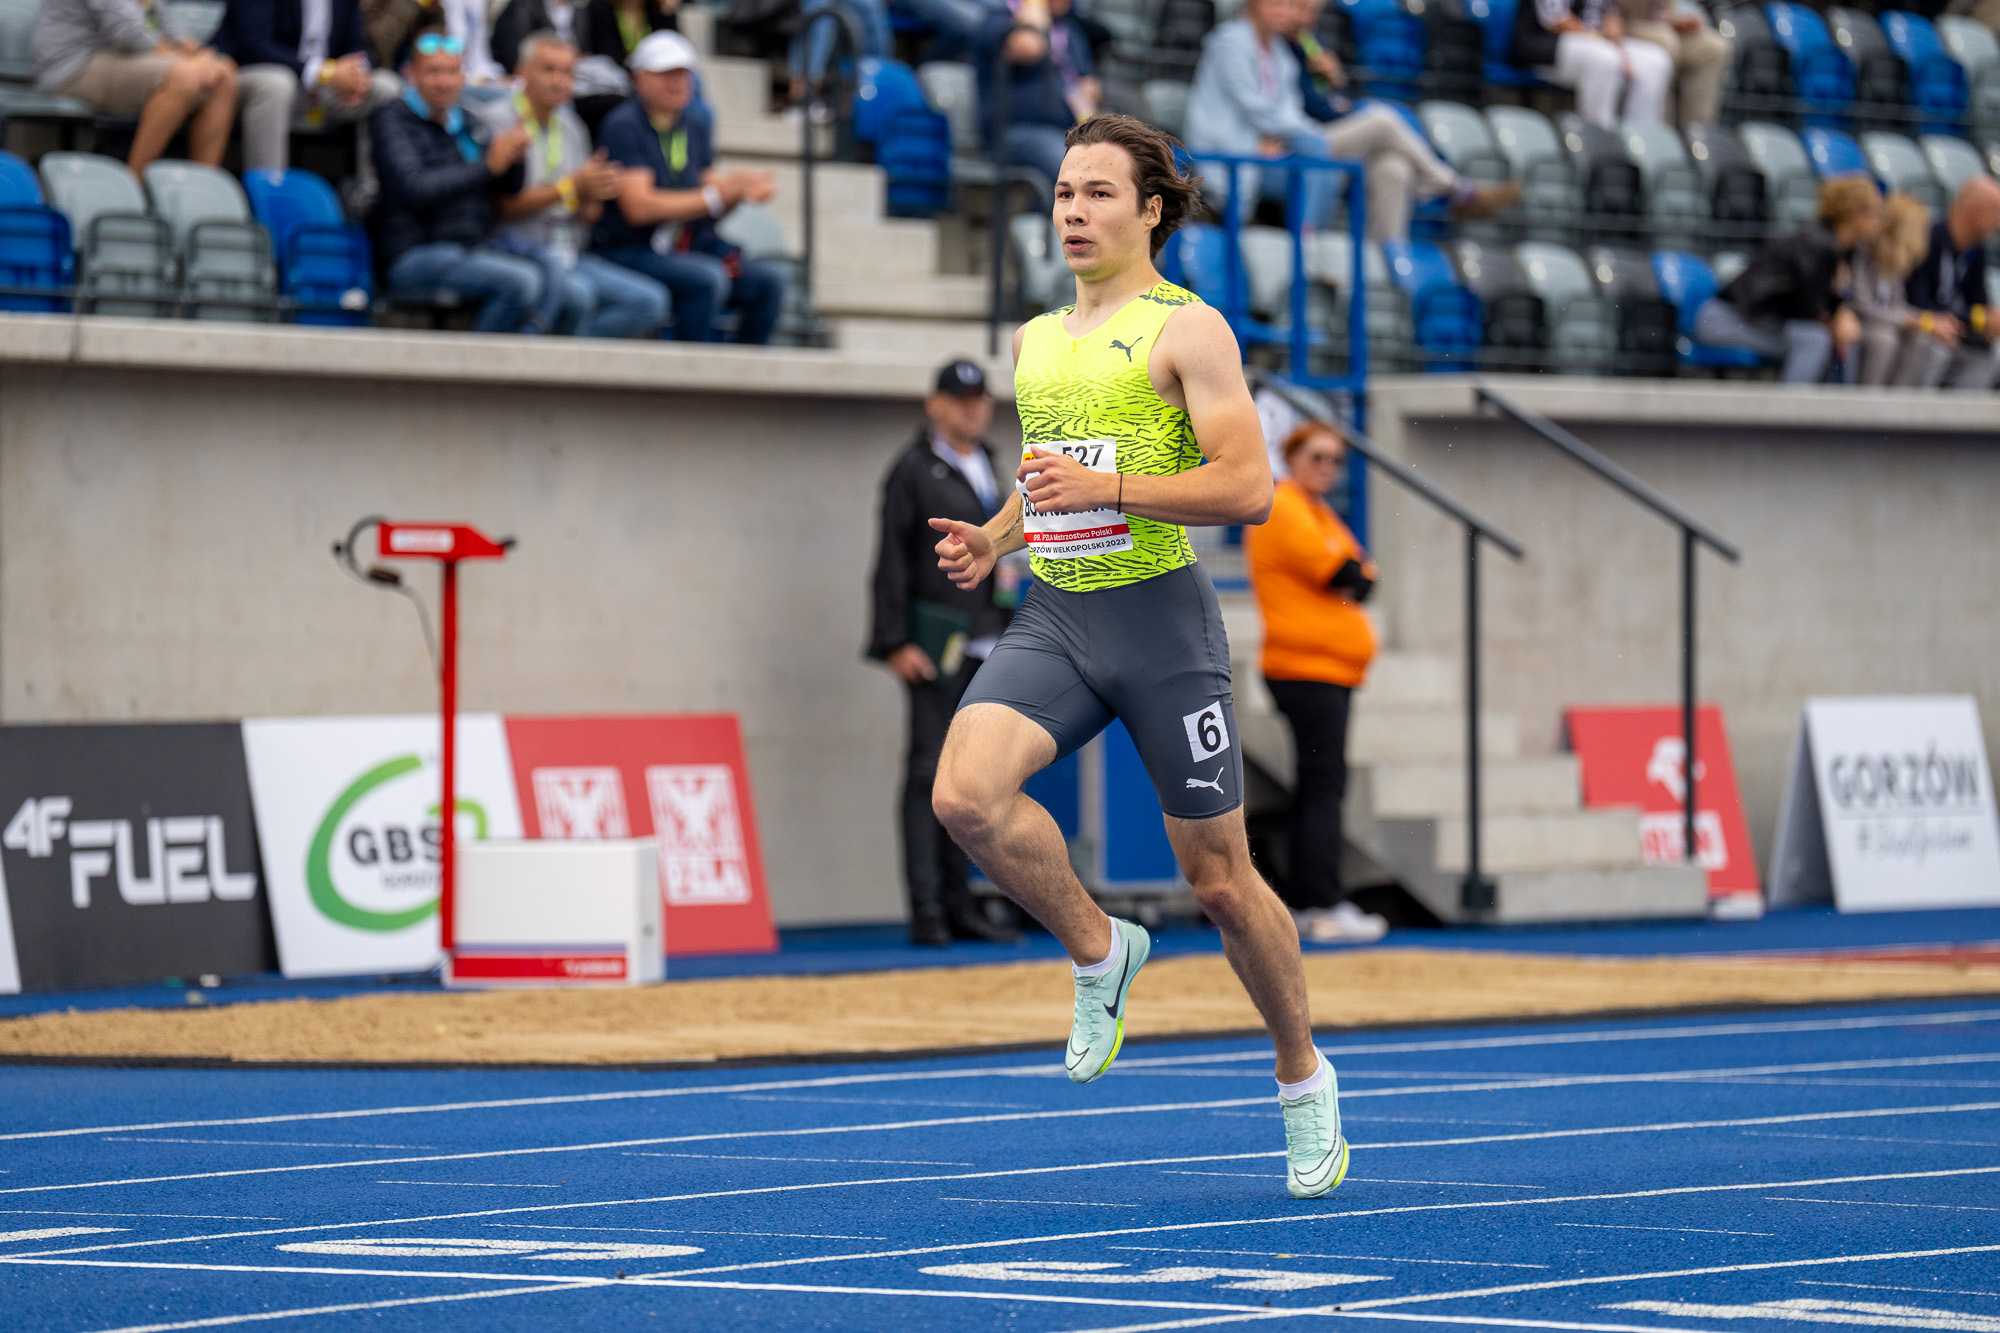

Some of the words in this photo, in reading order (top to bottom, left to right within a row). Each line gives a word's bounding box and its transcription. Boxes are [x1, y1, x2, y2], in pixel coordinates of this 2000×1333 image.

[1062, 444, 1105, 467] 527
[1053, 541, 1105, 554] WIELKOPOLSKI
[1105, 537, 1127, 548] 2023
[1091, 527, 1113, 538] Polski
[1197, 711, 1222, 752] 6
[3, 796, 72, 857] 4F
[348, 826, 443, 866] GBS
[68, 815, 256, 908] FUEL
